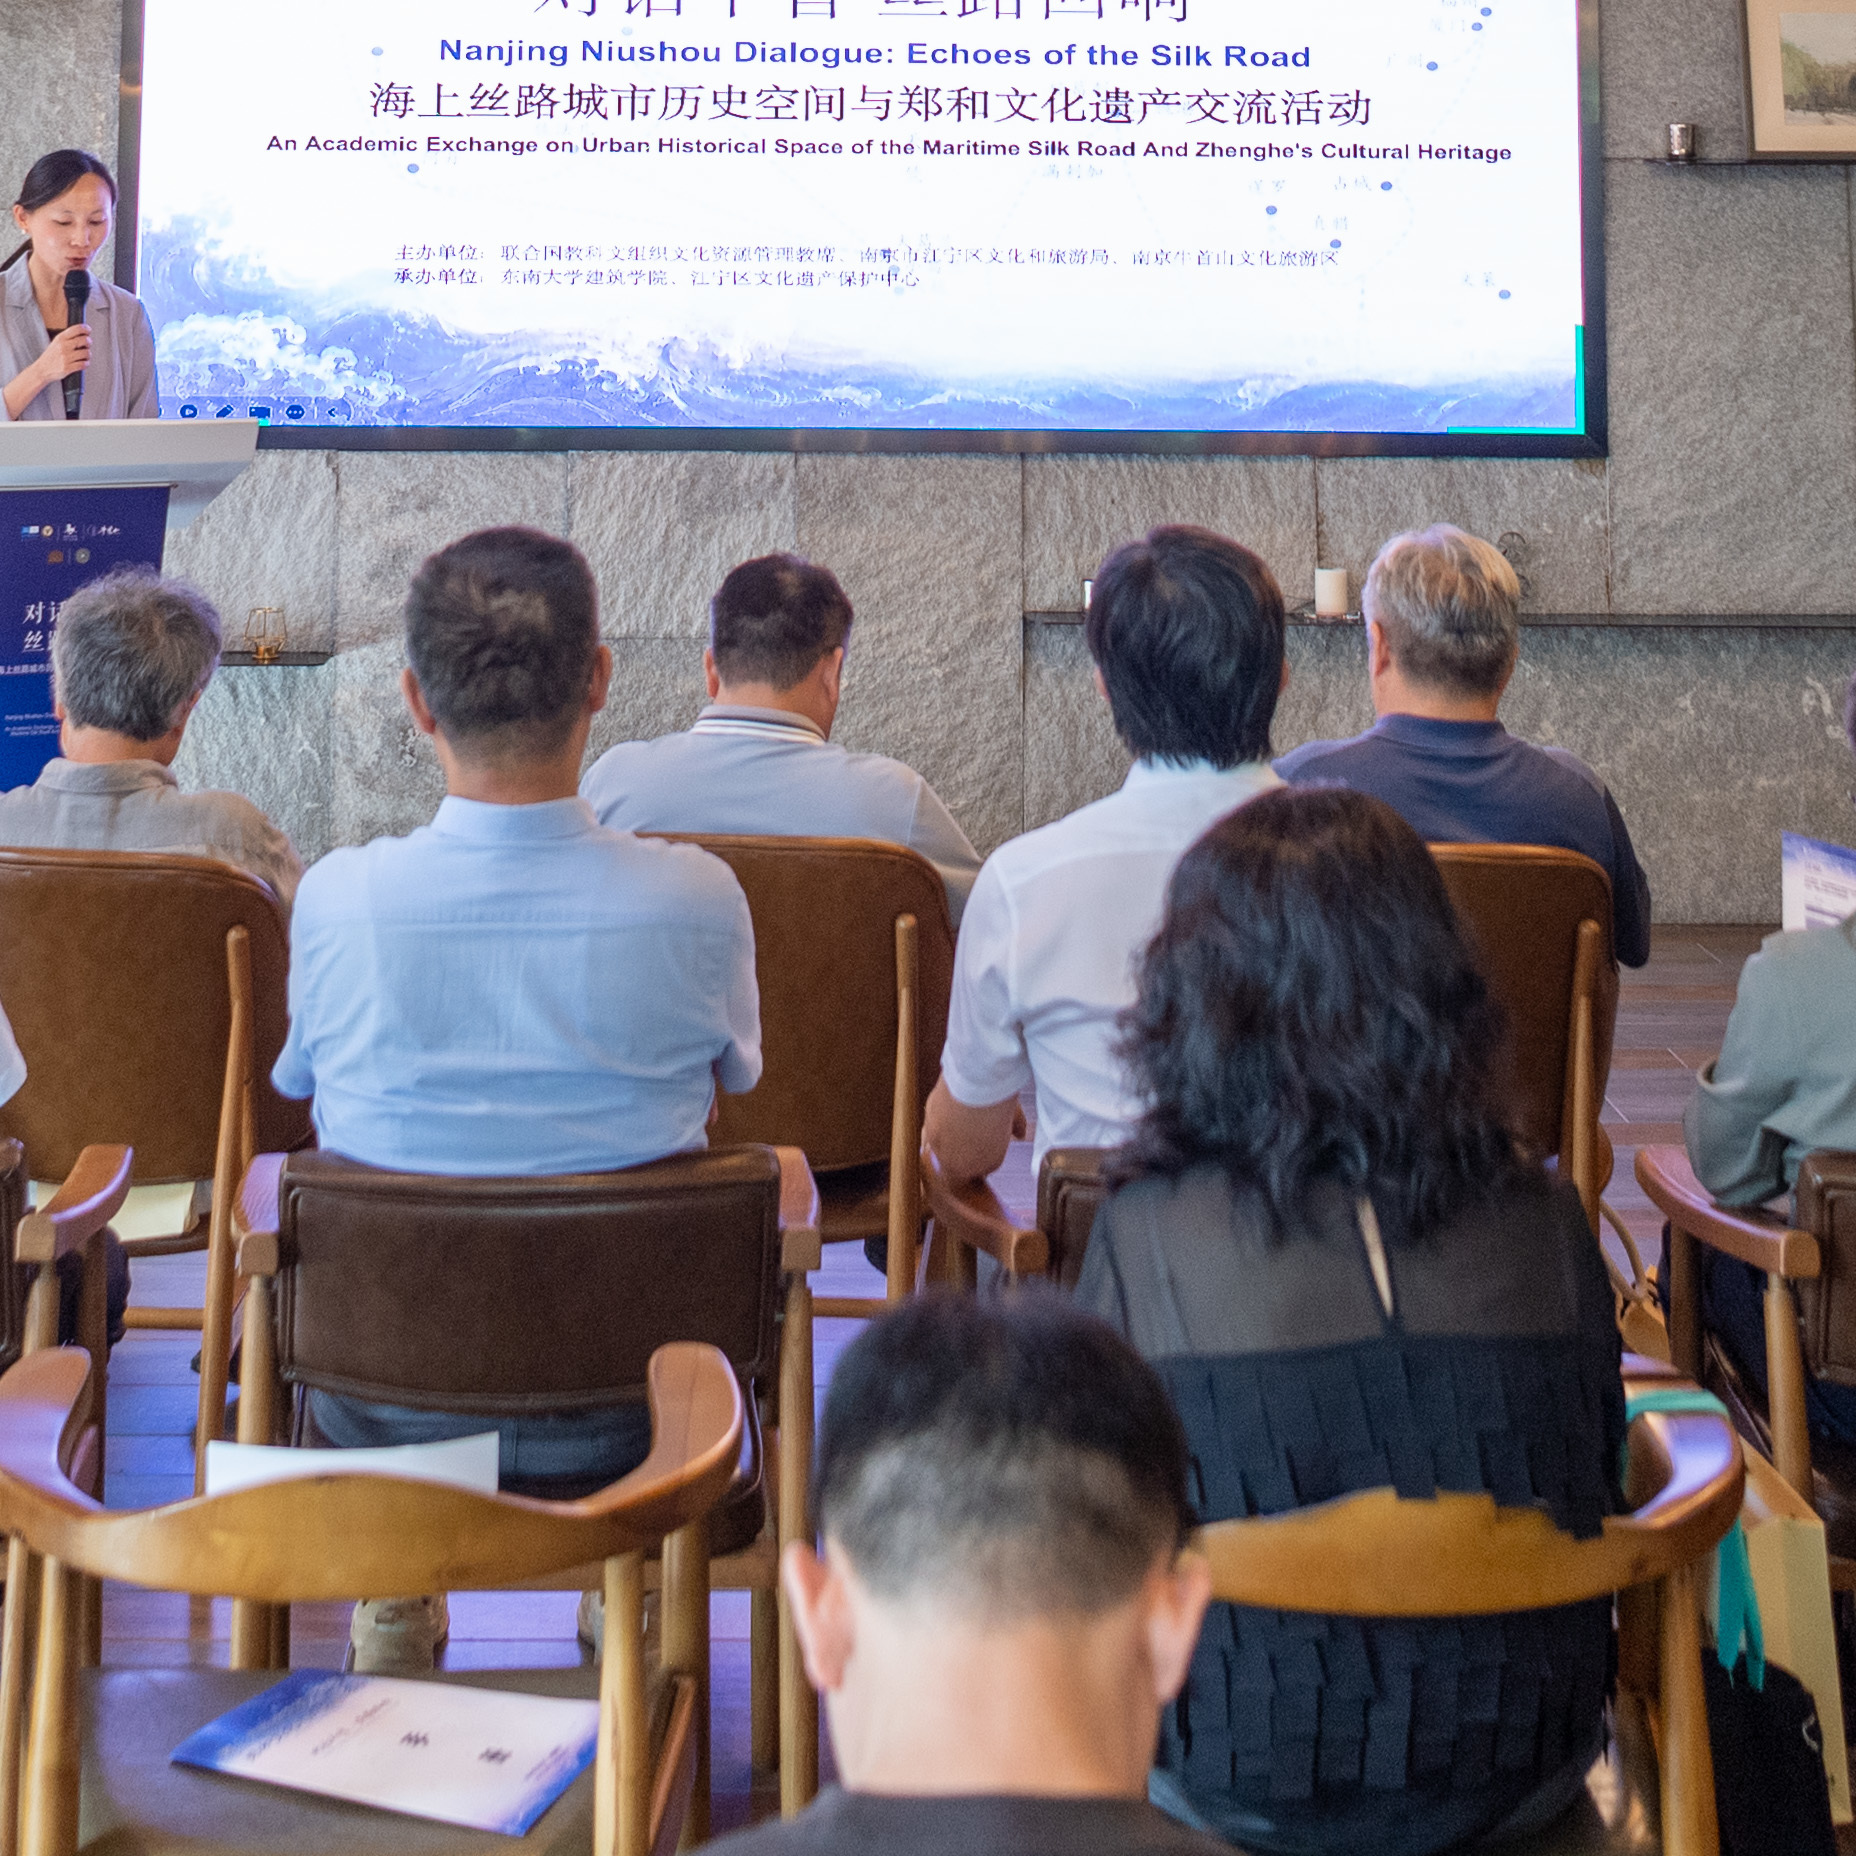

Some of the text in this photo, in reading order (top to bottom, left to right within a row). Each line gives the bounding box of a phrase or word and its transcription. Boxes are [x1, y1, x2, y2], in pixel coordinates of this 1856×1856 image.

[440, 39, 1310, 69] Nanjing Niushou Dialogue: Echoes of the Silk Road
[369, 81, 1372, 127] 海上丝路城市历史空间与郑和文化遗产交流活动
[267, 136, 1511, 163] An Academic Exchange on Urban Historical Space of the Maritime Silk Road And Zhenghe's Cultural Heritage
